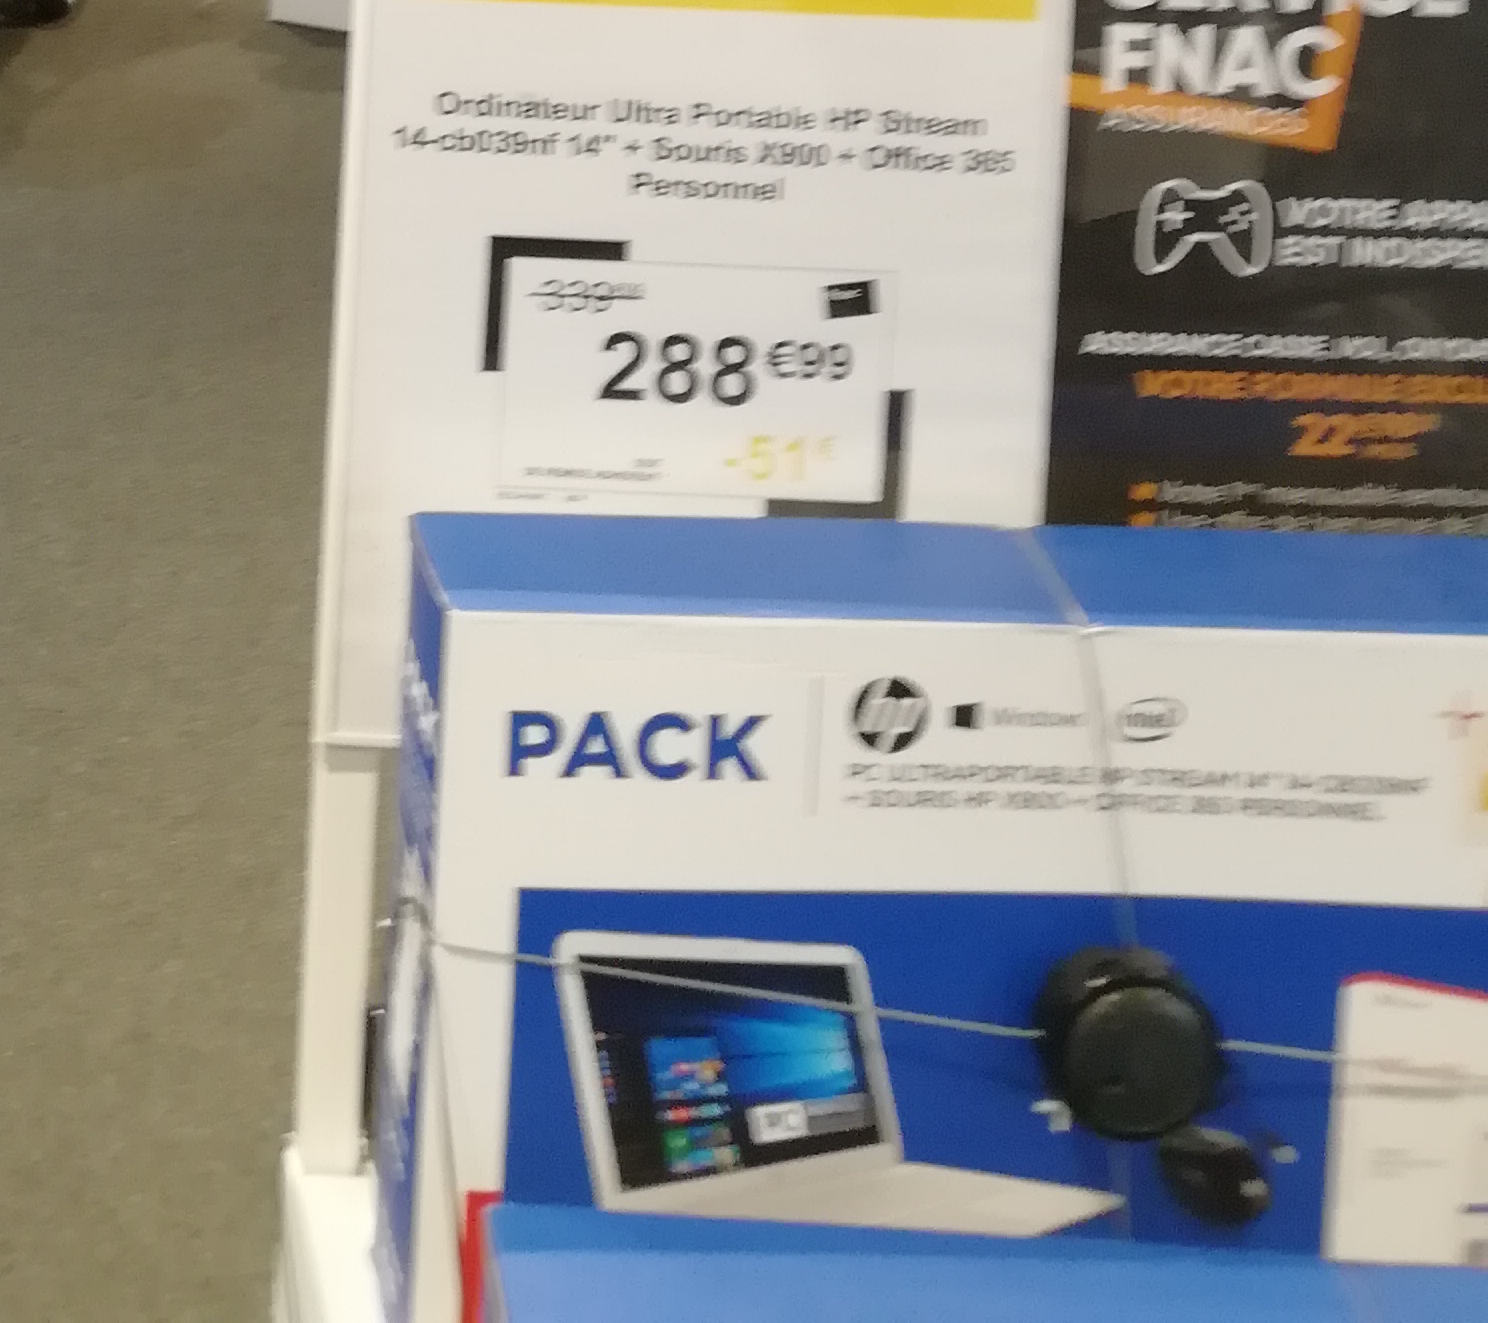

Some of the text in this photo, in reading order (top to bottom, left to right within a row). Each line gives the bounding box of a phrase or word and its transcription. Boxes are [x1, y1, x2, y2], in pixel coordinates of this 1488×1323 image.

[1100, 21, 1346, 101] FNAC
[432, 90, 602, 123] Ordinateur
[609, 98, 682, 125] Ultra
[686, 102, 817, 132] Portable
[502, 709, 773, 782] PACK
